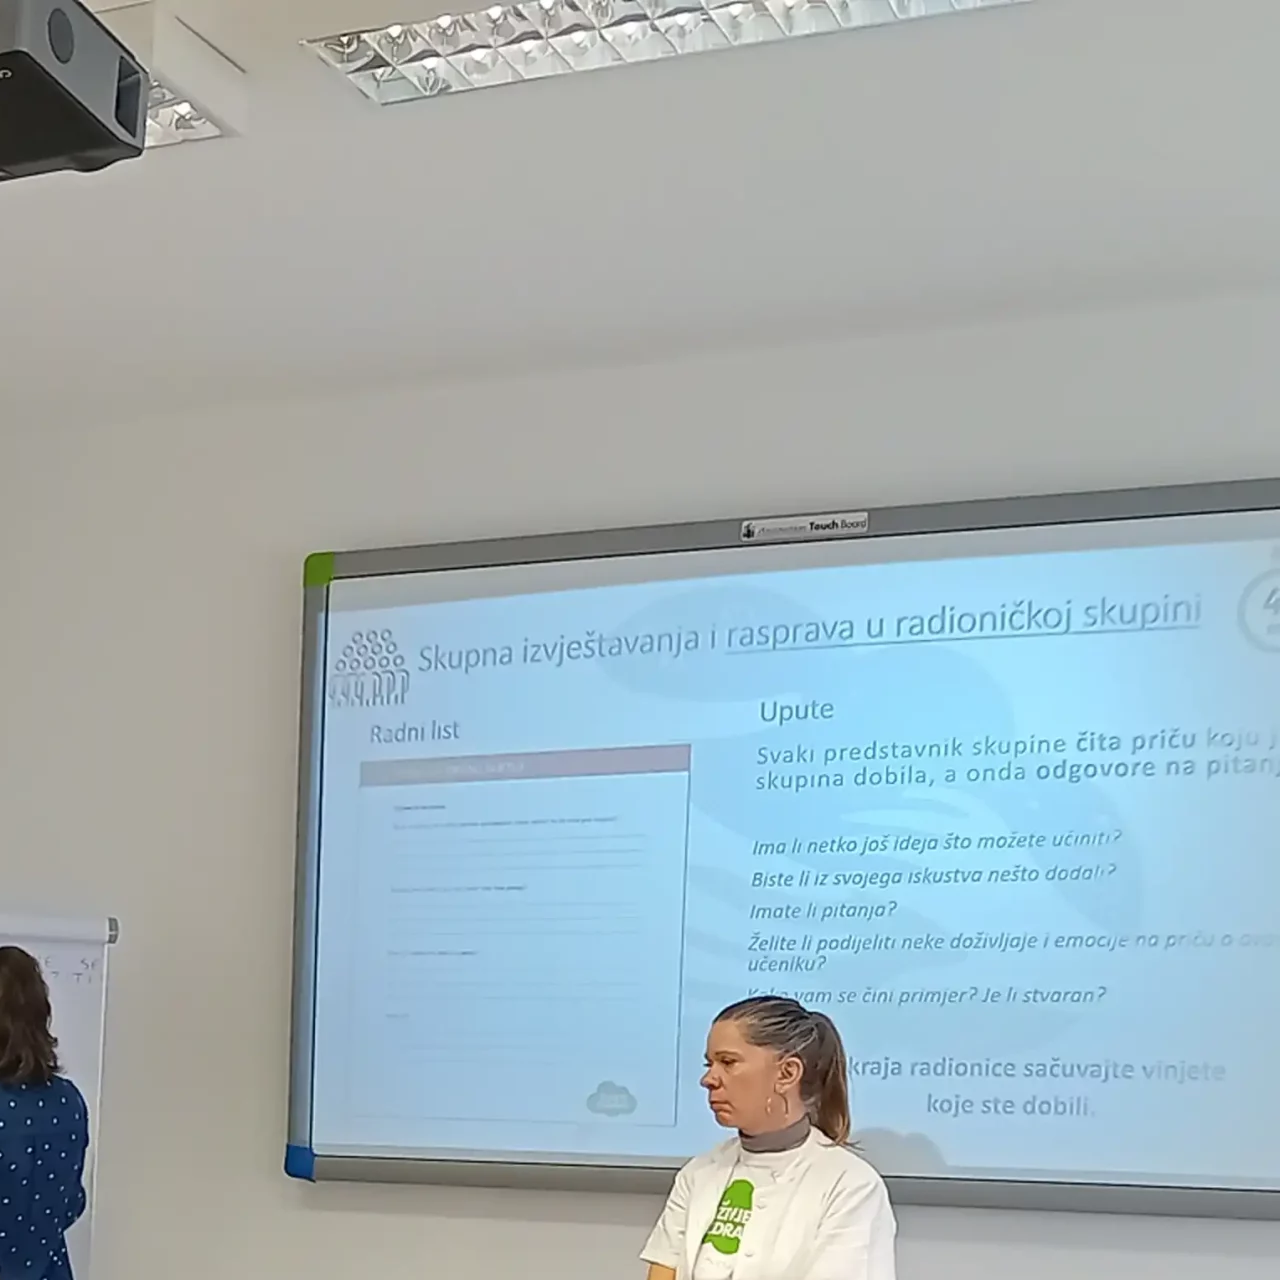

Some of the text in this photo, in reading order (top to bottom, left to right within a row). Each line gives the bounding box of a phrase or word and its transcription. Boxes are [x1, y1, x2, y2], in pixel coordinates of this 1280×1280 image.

[809, 520, 839, 531] Touch
[418, 592, 1202, 676] Skupna izvještavanja i rasprava u radioničkoj skupini
[759, 699, 835, 726] Upute
[370, 720, 460, 744] Radni list
[756, 744, 815, 765] Svaki
[823, 739, 962, 766] predstavnik
[972, 733, 1067, 760] skupine
[1076, 730, 1121, 753] čita
[1131, 726, 1197, 752] priču
[1206, 726, 1259, 752] koju
[756, 766, 844, 793] skupina
[853, 764, 936, 787] dobila,
[944, 767, 957, 783] a
[966, 759, 1026, 782] onda
[1036, 757, 1157, 784] odgovore
[1165, 759, 1195, 776] na
[753, 828, 1122, 857] Ima li netko još ideja što možete učiniti?
[751, 862, 1117, 893] Biste li iz svojega iskustva nešto dodali?
[749, 900, 898, 923] Imate li pitanja?
[747, 932, 798, 952] Želite
[801, 933, 814, 951] li
[816, 933, 896, 956] podijeliti
[900, 933, 946, 950] neke
[949, 931, 1038, 955] doživljaje
[1053, 932, 1129, 953] emocije
[1134, 934, 1159, 949] na
[748, 954, 827, 975] učeniku?
[793, 991, 833, 1004] vam
[837, 991, 858, 1004] se
[861, 986, 894, 1004] čini
[898, 984, 978, 1008] primjer?
[980, 984, 1003, 1005] Je
[1006, 983, 1018, 1002] li
[1022, 983, 1108, 1004] stvaran?
[848, 1055, 1227, 1084] kraja radionice sačuvajte vinjete
[926, 1093, 1097, 1119] koje ste dobili.
